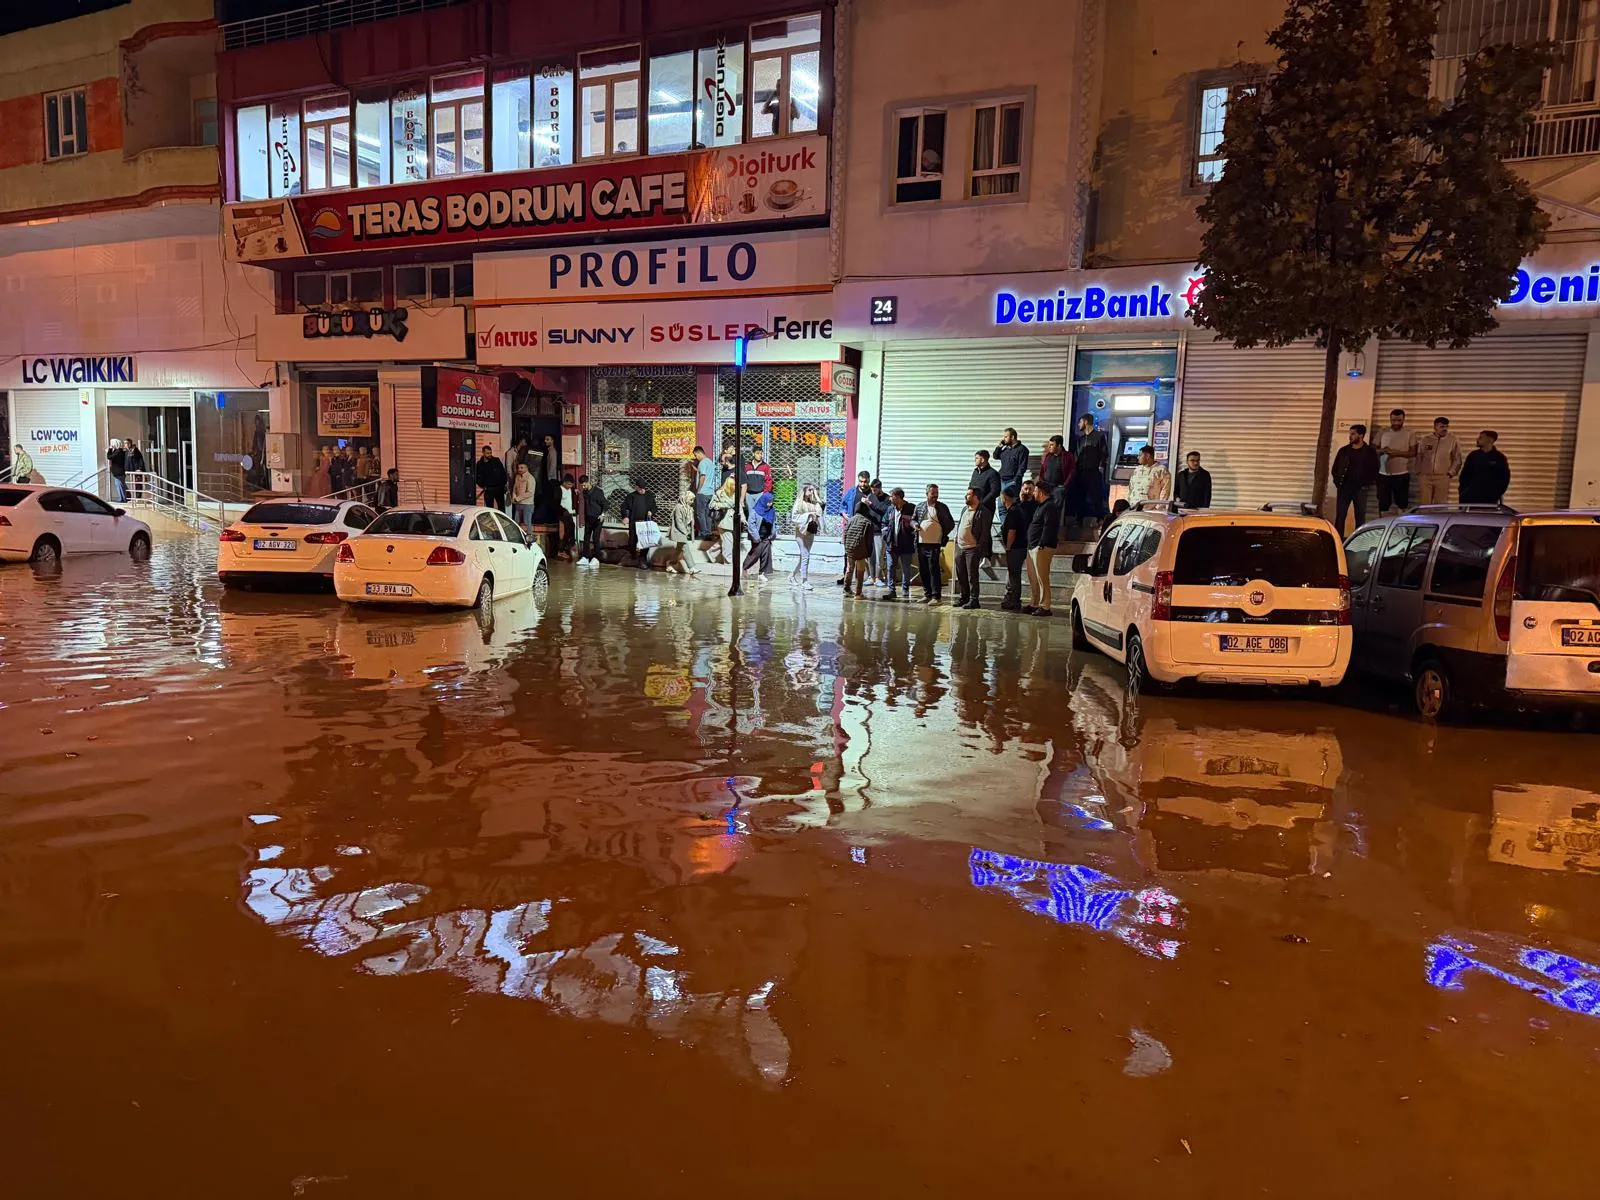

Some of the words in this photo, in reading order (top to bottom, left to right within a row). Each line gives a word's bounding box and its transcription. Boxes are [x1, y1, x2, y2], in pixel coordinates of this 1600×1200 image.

[716, 33, 726, 137] DIGITURK
[550, 87, 560, 156] BODRUM
[347, 197, 441, 238] TERAS
[446, 183, 583, 229] BODRUM
[591, 172, 686, 217] CAFE
[874, 300, 893, 314] 24
[996, 285, 1172, 324] DenizBank
[495, 330, 538, 347] ALTUS
[548, 327, 635, 344] SUNNY
[22, 358, 48, 383] LC
[455, 393, 483, 406] TERAS
[441, 405, 474, 417] BODRUM
[475, 410, 495, 419] CAFE
[1228, 637, 1239, 648] 02
[1246, 637, 1262, 648] AGE
[1269, 638, 1286, 649] 086
[1570, 631, 1584, 642] 02
